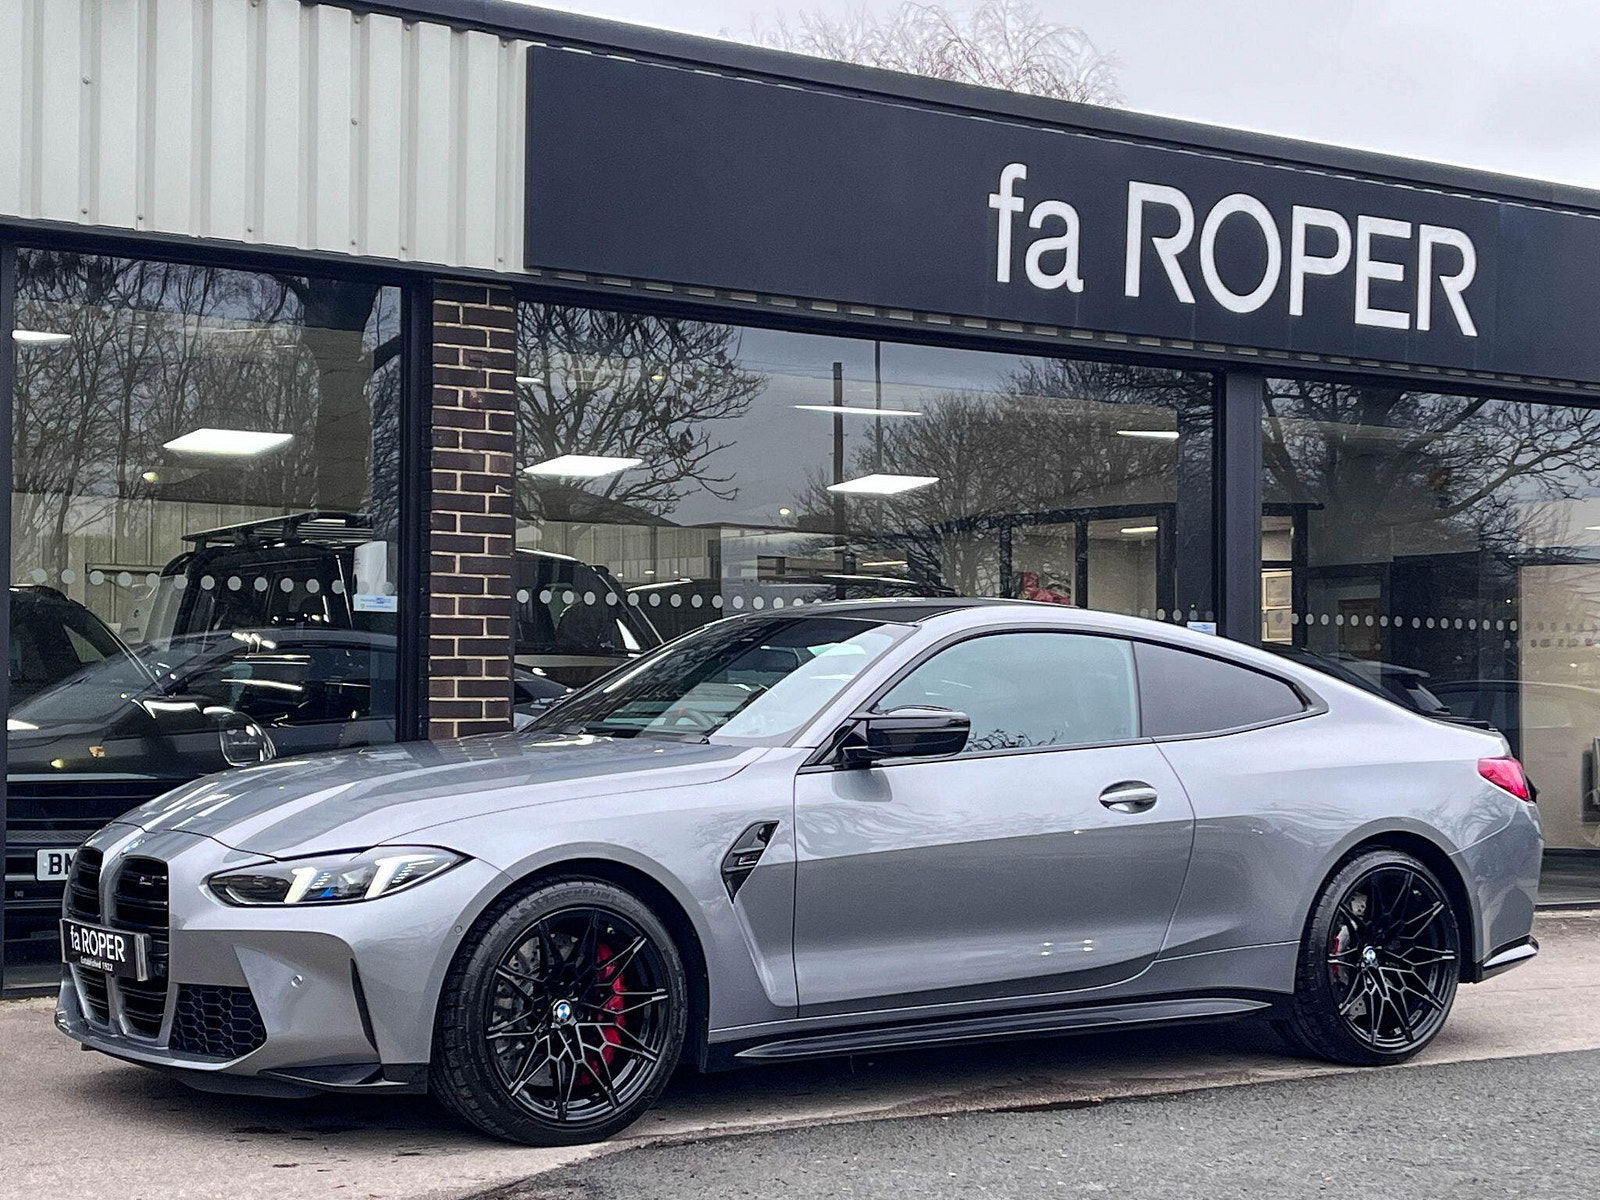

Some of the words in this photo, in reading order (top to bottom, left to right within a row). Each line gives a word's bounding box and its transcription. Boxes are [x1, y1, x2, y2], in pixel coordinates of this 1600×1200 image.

[989, 163, 1084, 293] fa
[1124, 180, 1478, 337] ROPER
[70, 925, 81, 951] fa
[81, 927, 126, 962] ROPER
